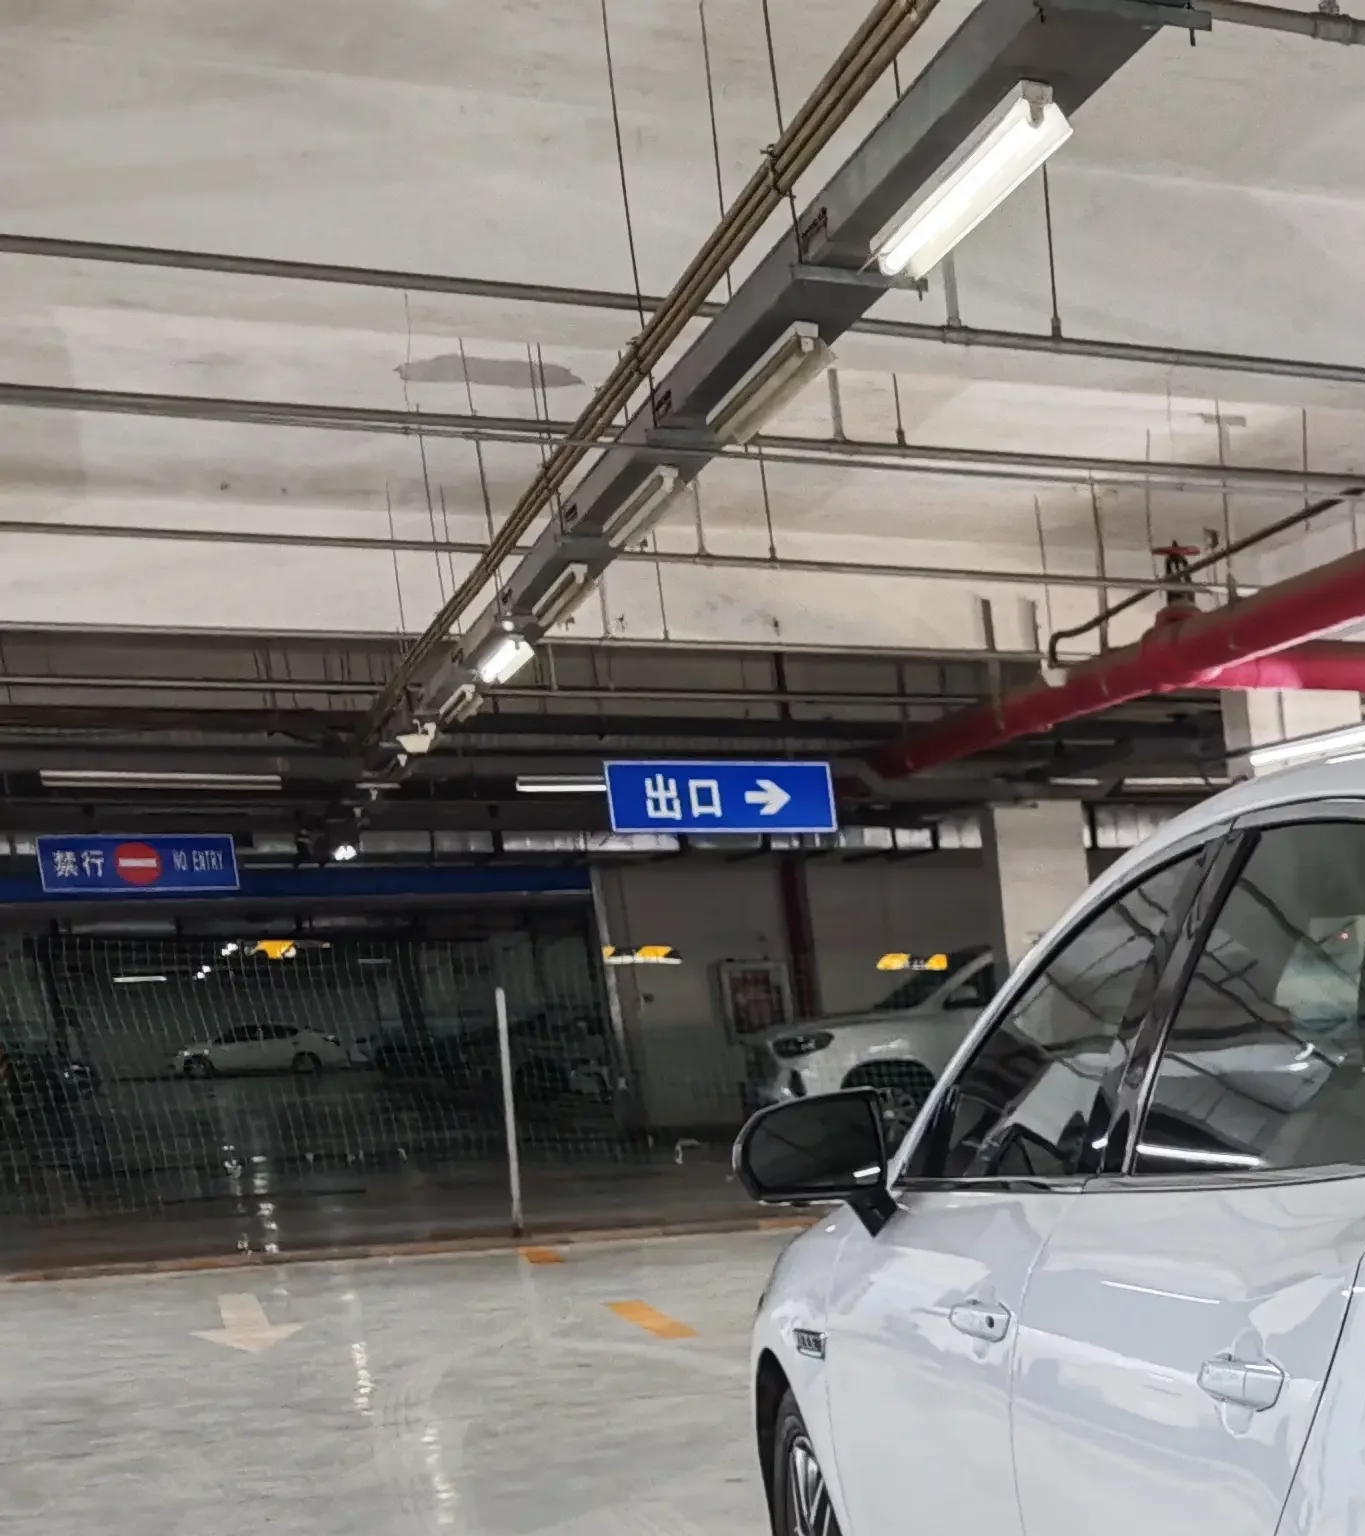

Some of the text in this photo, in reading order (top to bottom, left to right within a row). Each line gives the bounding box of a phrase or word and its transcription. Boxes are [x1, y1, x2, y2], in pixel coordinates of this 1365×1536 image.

[644, 773, 723, 821] 出口
[52, 850, 105, 878] 禁行
[172, 848, 225, 872] NO ENTRY
